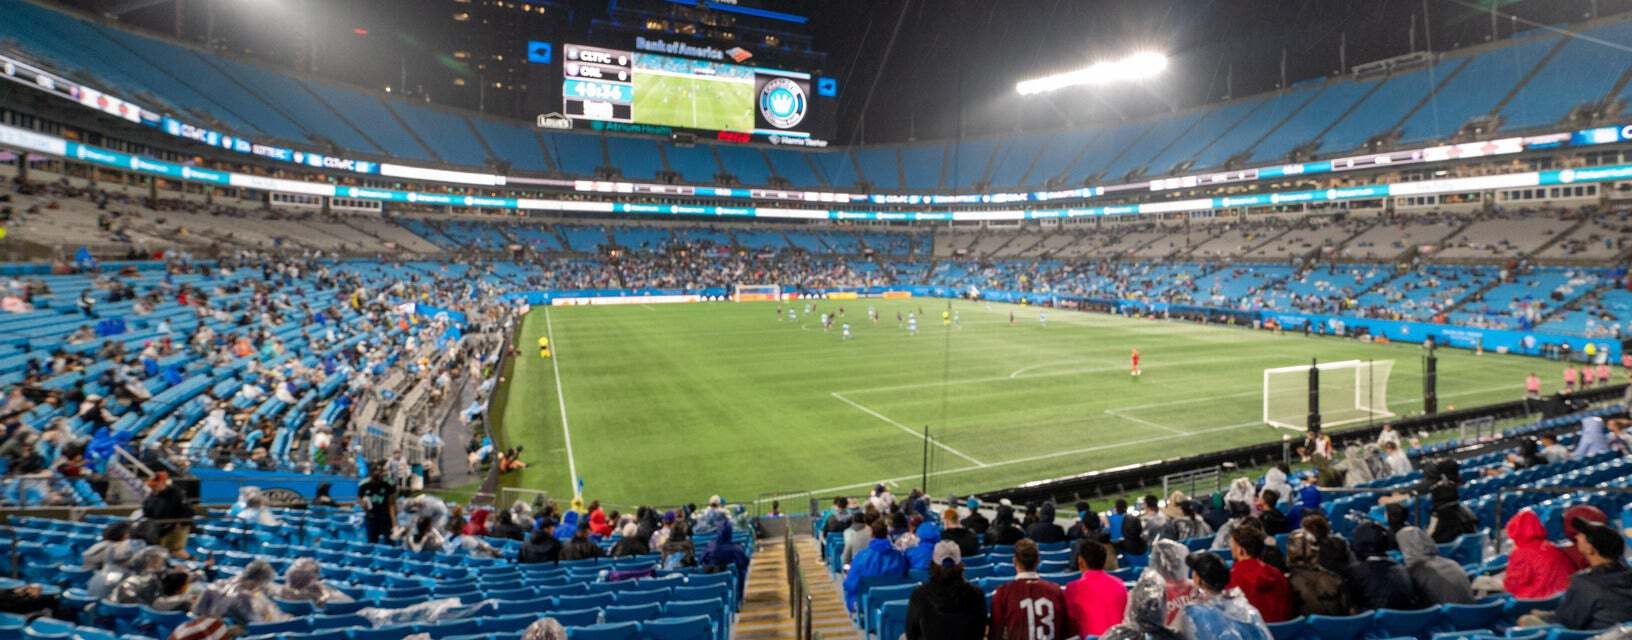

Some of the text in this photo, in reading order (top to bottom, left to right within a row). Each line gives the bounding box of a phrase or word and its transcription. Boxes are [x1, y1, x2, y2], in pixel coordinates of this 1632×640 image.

[636, 36, 723, 60] Bank of America
[1019, 597, 1056, 640] 13
